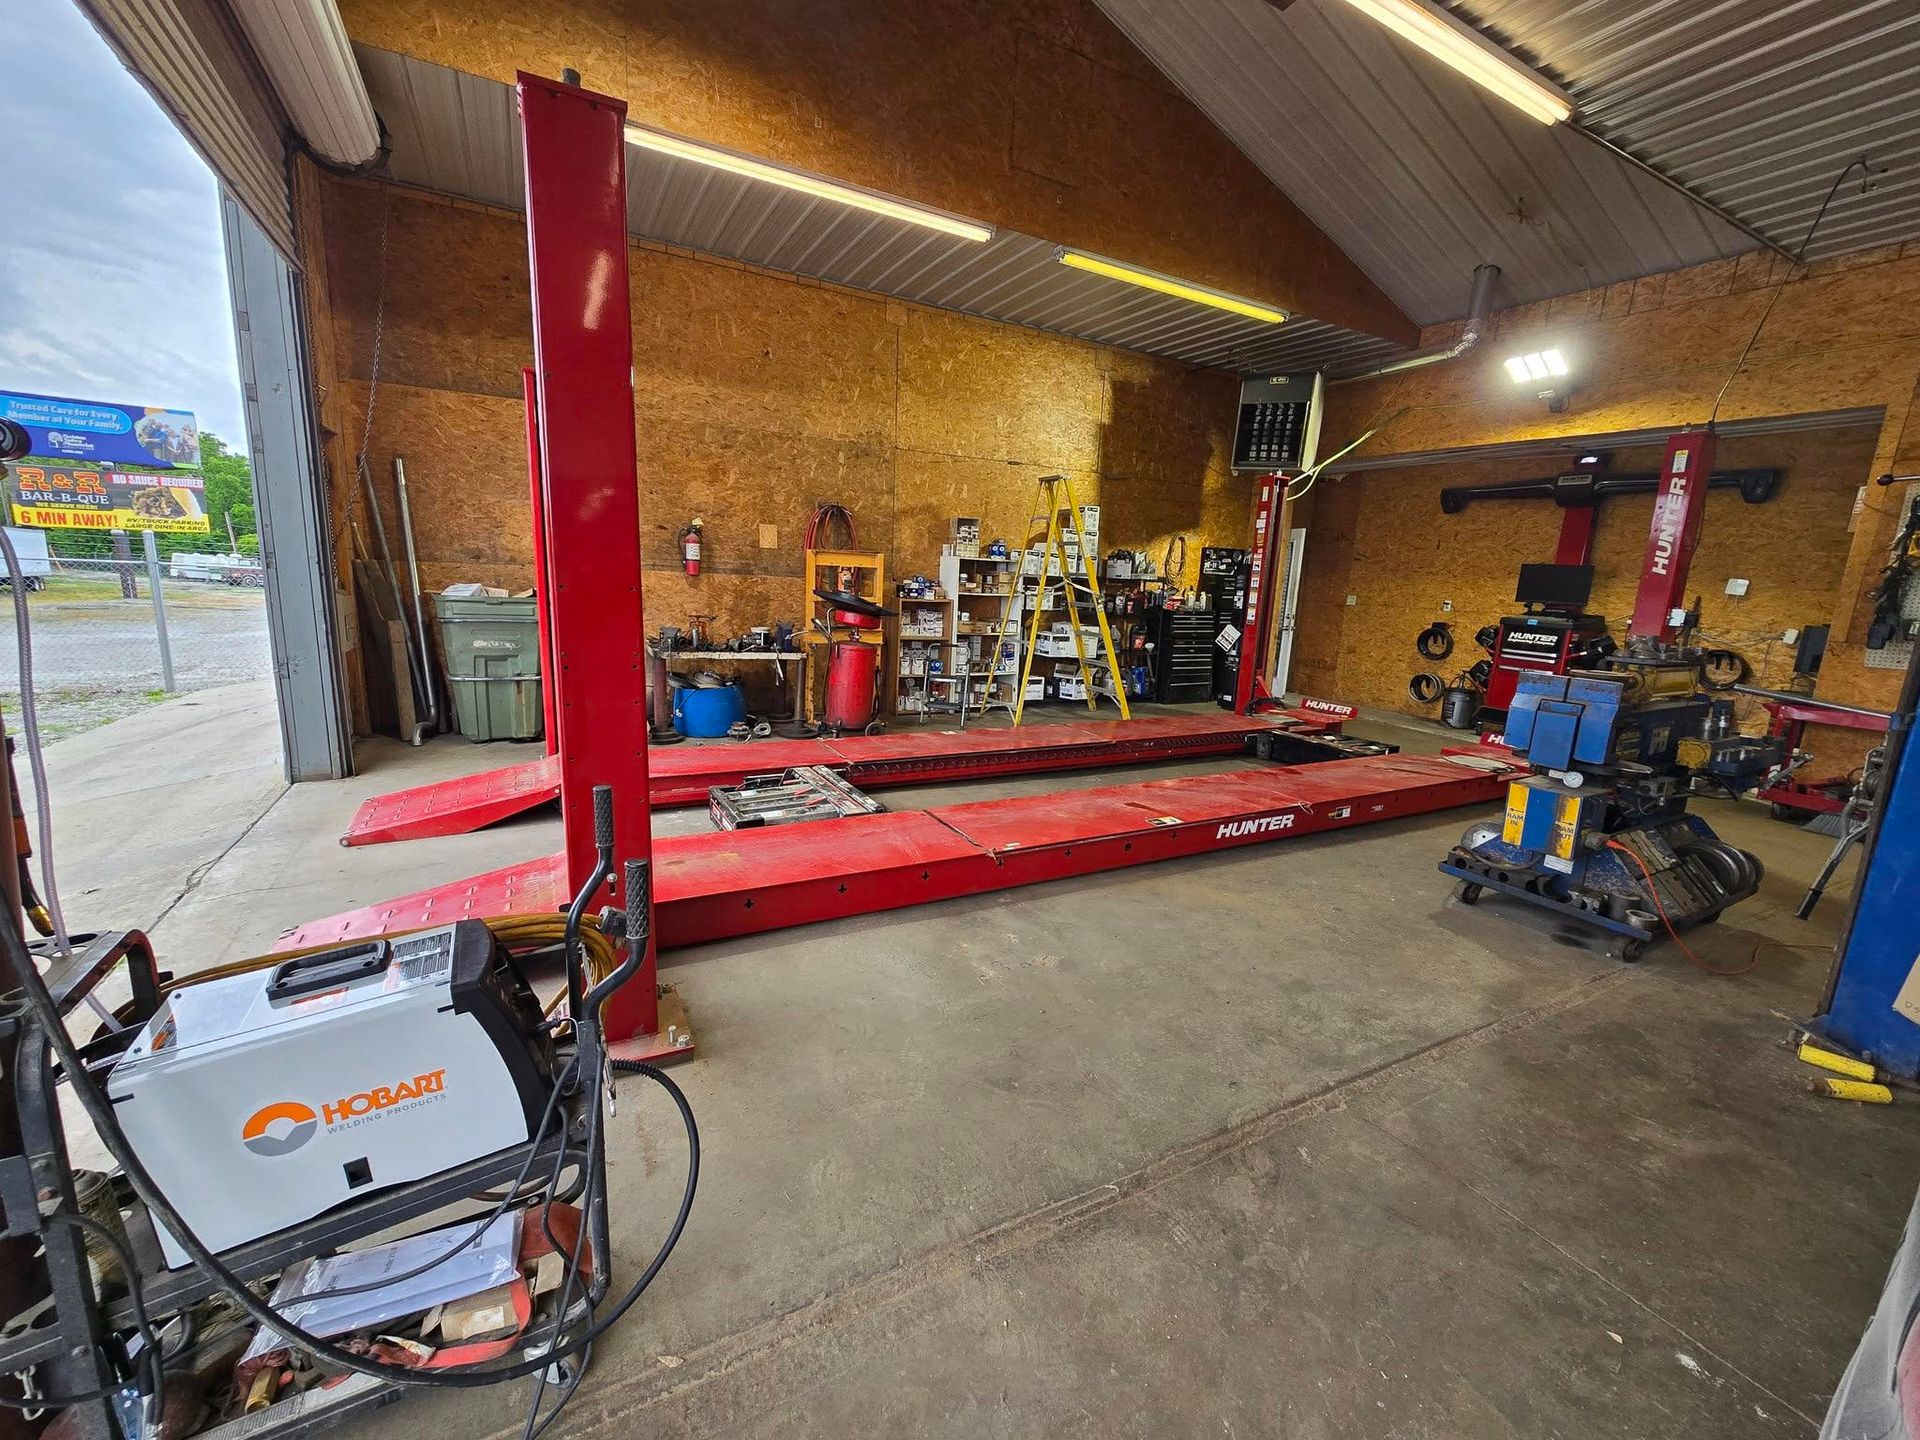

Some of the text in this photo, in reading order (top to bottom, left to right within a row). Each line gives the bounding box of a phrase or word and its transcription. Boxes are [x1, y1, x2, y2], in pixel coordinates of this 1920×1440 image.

[8, 410, 50, 422] Member
[52, 415, 62, 423] of
[65, 417, 88, 426] Your
[10, 401, 118, 421] Trusted Care for Every
[15, 467, 107, 495] R&R
[128, 475, 159, 486] SAUCE
[161, 476, 204, 489] REQUIRED
[21, 490, 110, 505] BAR-B-QUE
[20, 511, 119, 528] 6 MIN AWAY!
[126, 517, 205, 527] RV/TRUCK PARKING
[1651, 476, 1687, 576] HUNTER
[1508, 632, 1559, 642] HUNTER
[1305, 699, 1352, 715] HUNTER
[1507, 812, 1524, 821] RAM
[1216, 814, 1295, 840] HUNTER
[321, 1069, 446, 1125] HOBART
[327, 1094, 447, 1135] WELDING PRODUCTS
